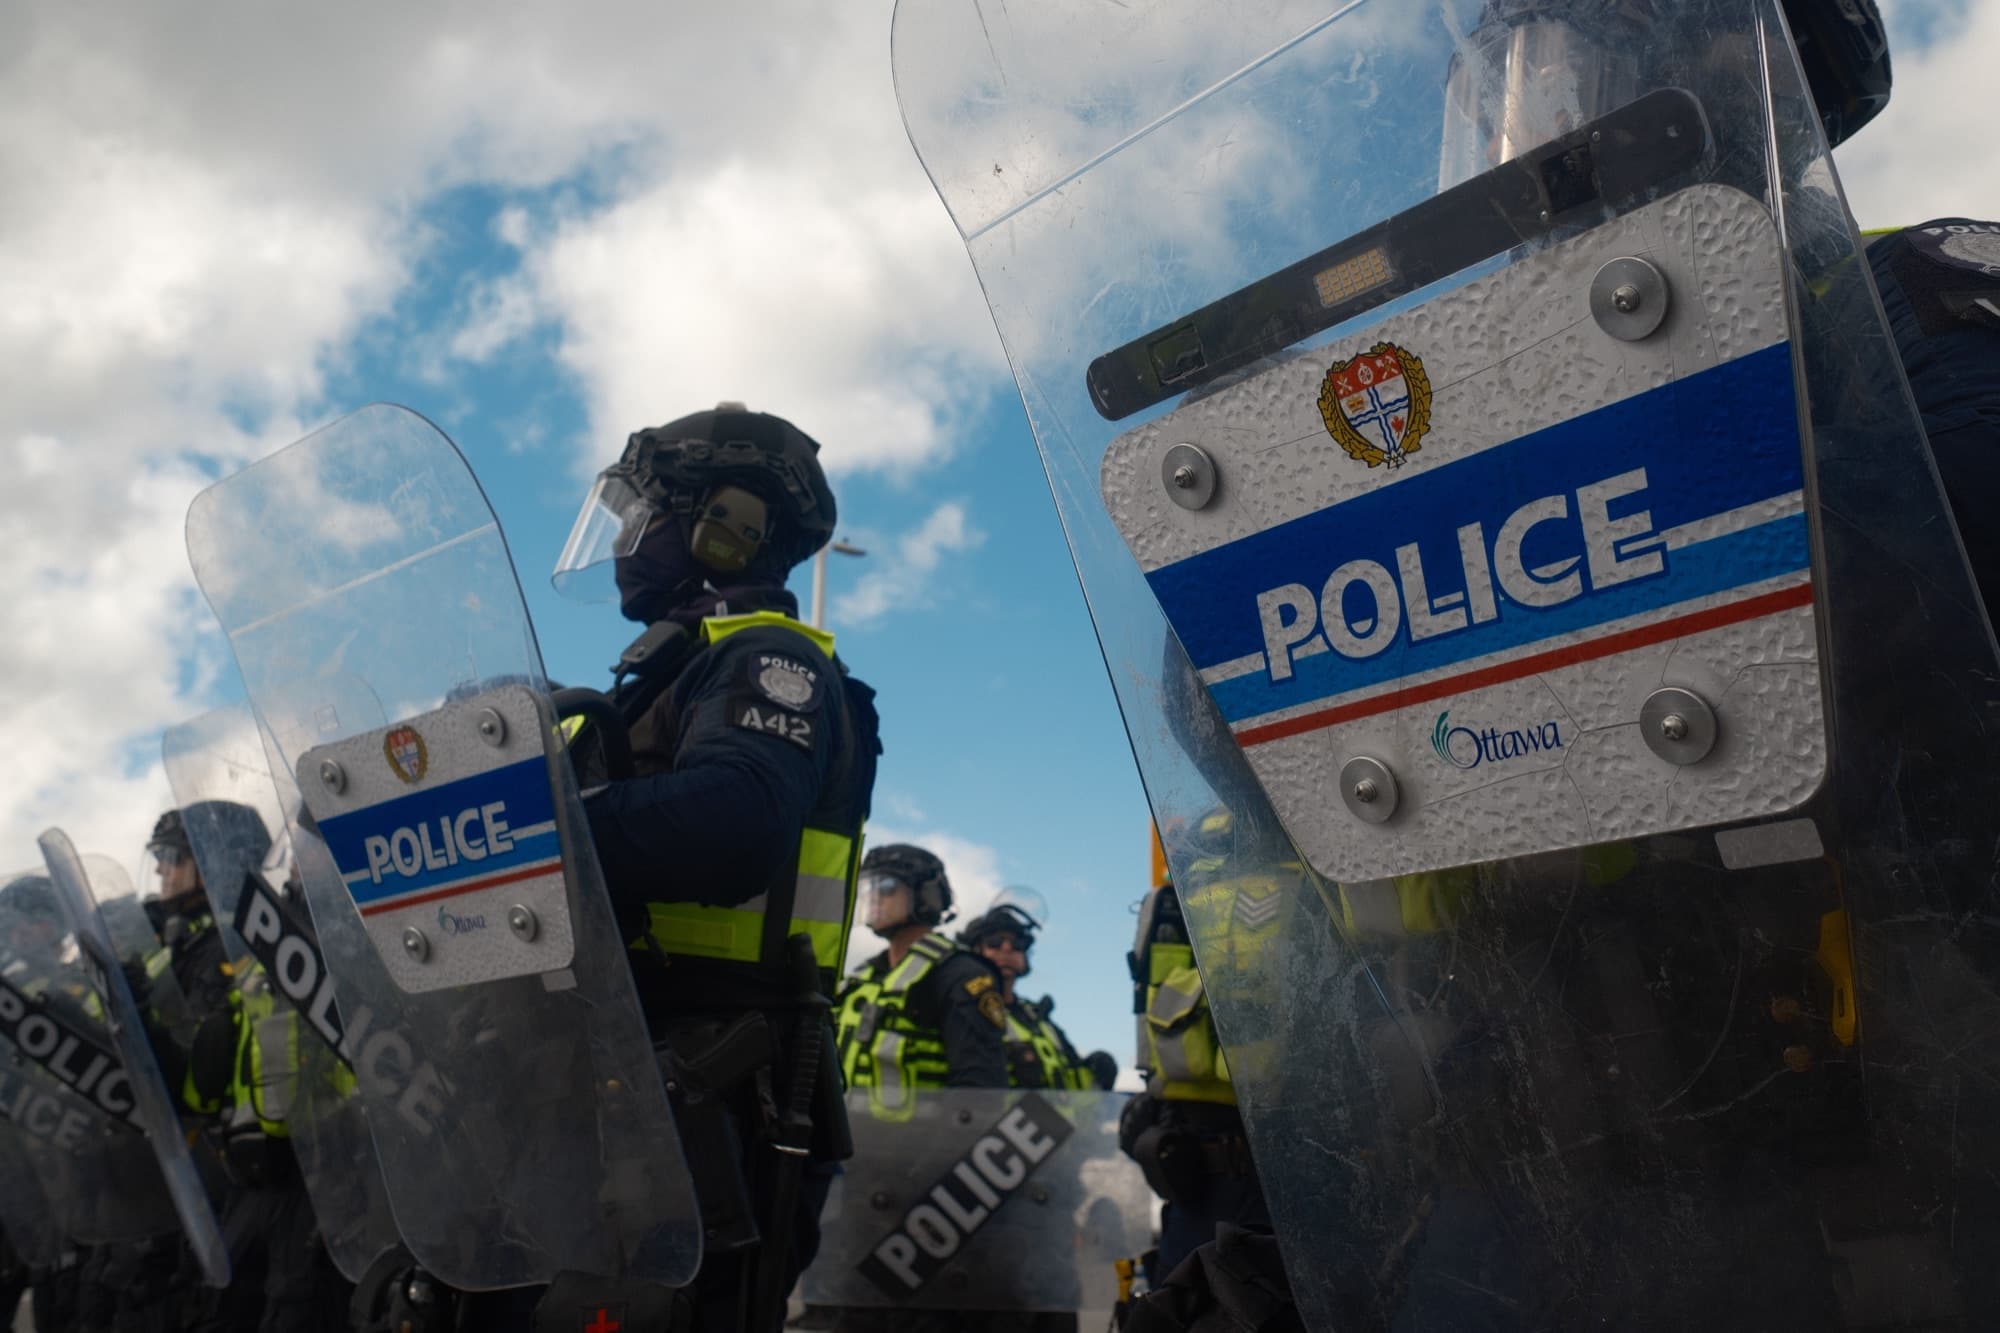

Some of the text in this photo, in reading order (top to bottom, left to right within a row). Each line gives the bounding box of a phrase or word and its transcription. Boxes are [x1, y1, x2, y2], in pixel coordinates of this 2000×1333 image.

[1257, 467, 1665, 682] POLICE
[760, 656, 816, 682] POLICE
[741, 707, 811, 746] A42
[1446, 721, 1563, 769] Ottawa
[365, 800, 514, 884] POLICE
[0, 986, 143, 1130] POLIC
[243, 888, 454, 1136] POLICE
[874, 1106, 1055, 1290] POLICE
